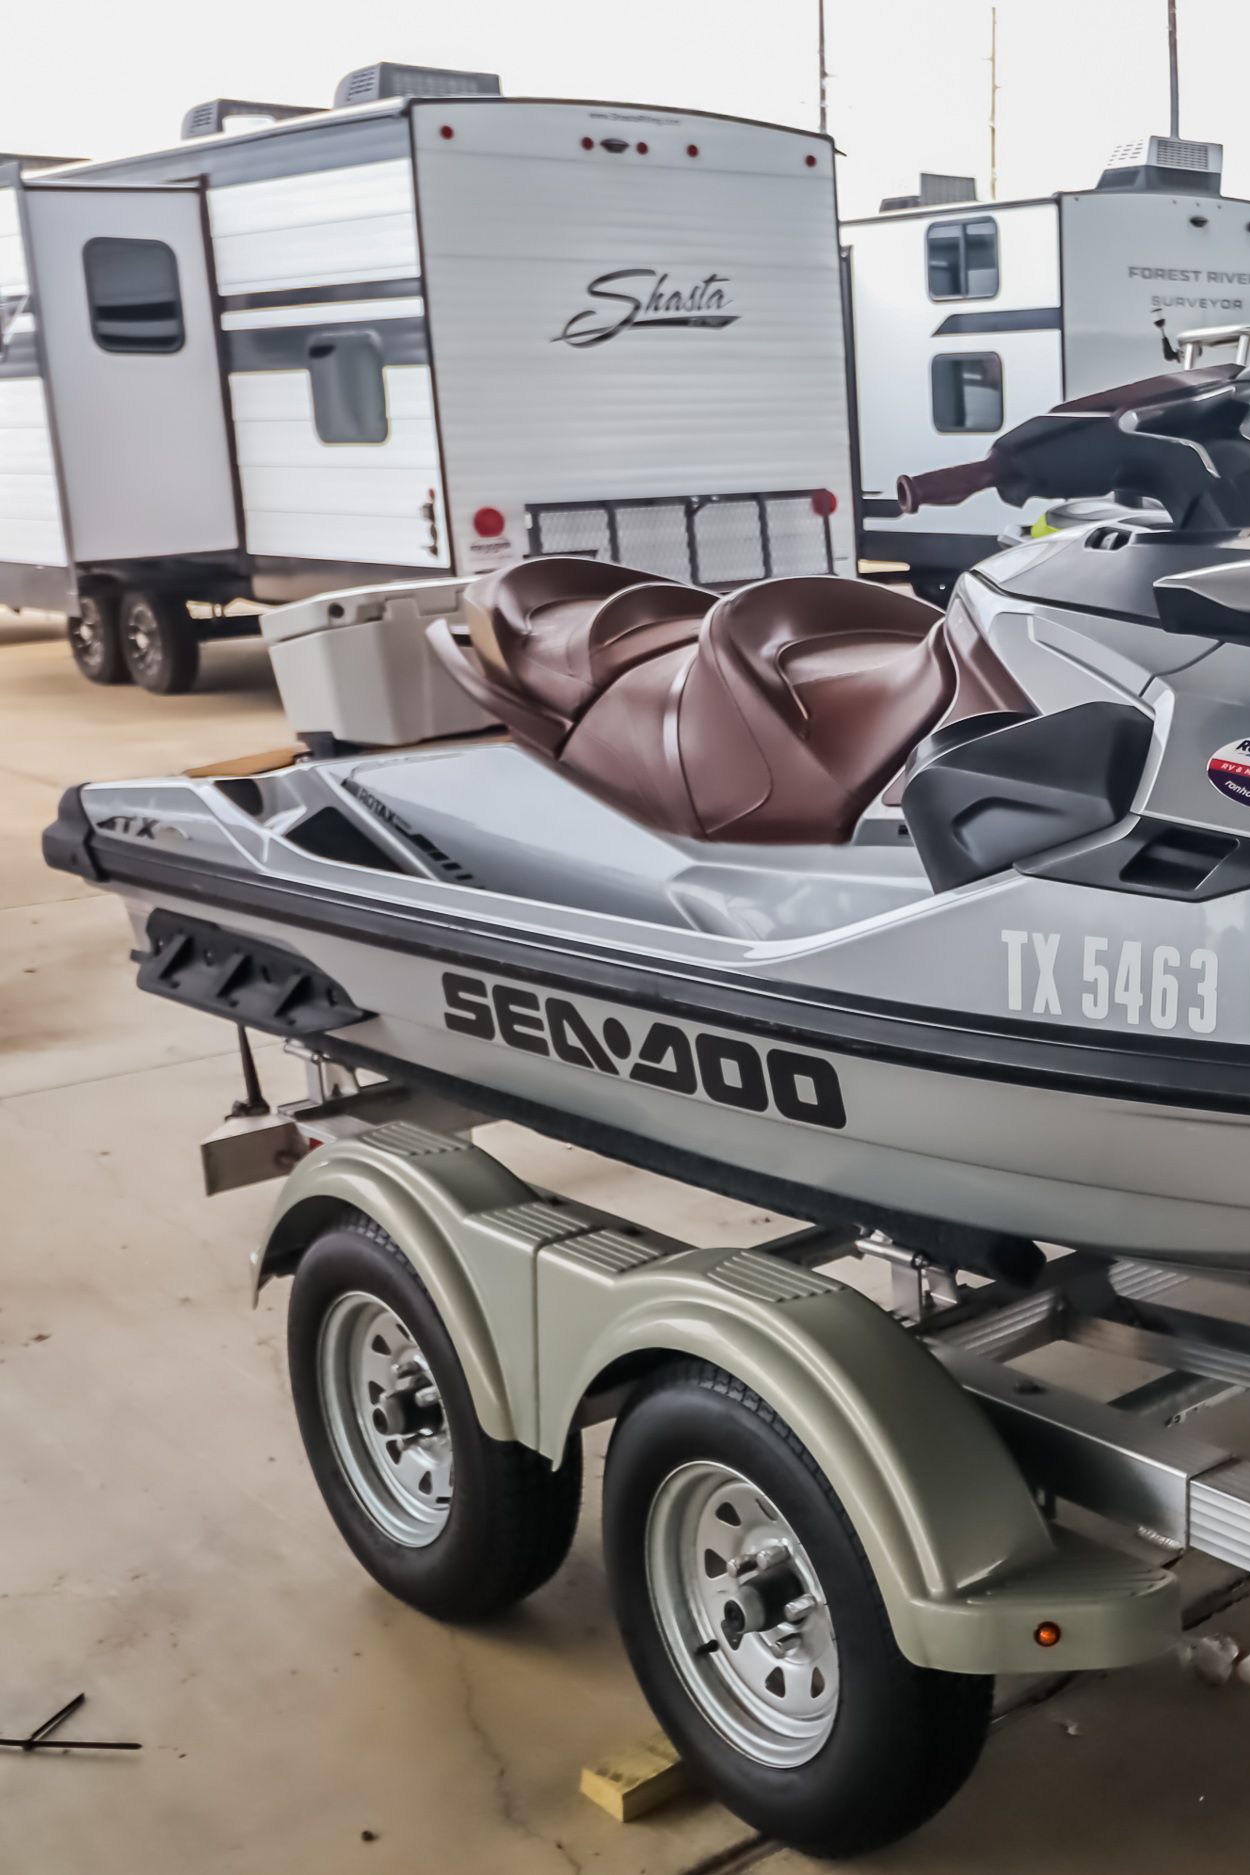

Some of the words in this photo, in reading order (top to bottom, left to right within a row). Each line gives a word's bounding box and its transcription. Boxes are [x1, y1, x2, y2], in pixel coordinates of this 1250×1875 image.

[1128, 266, 1202, 283] FOREST
[556, 269, 735, 348] Shasta
[1151, 295, 1243, 310] SURVEYOR
[1220, 763, 1235, 771] RV
[1001, 930, 1062, 1015] TX
[1081, 935, 1219, 1034] 5463
